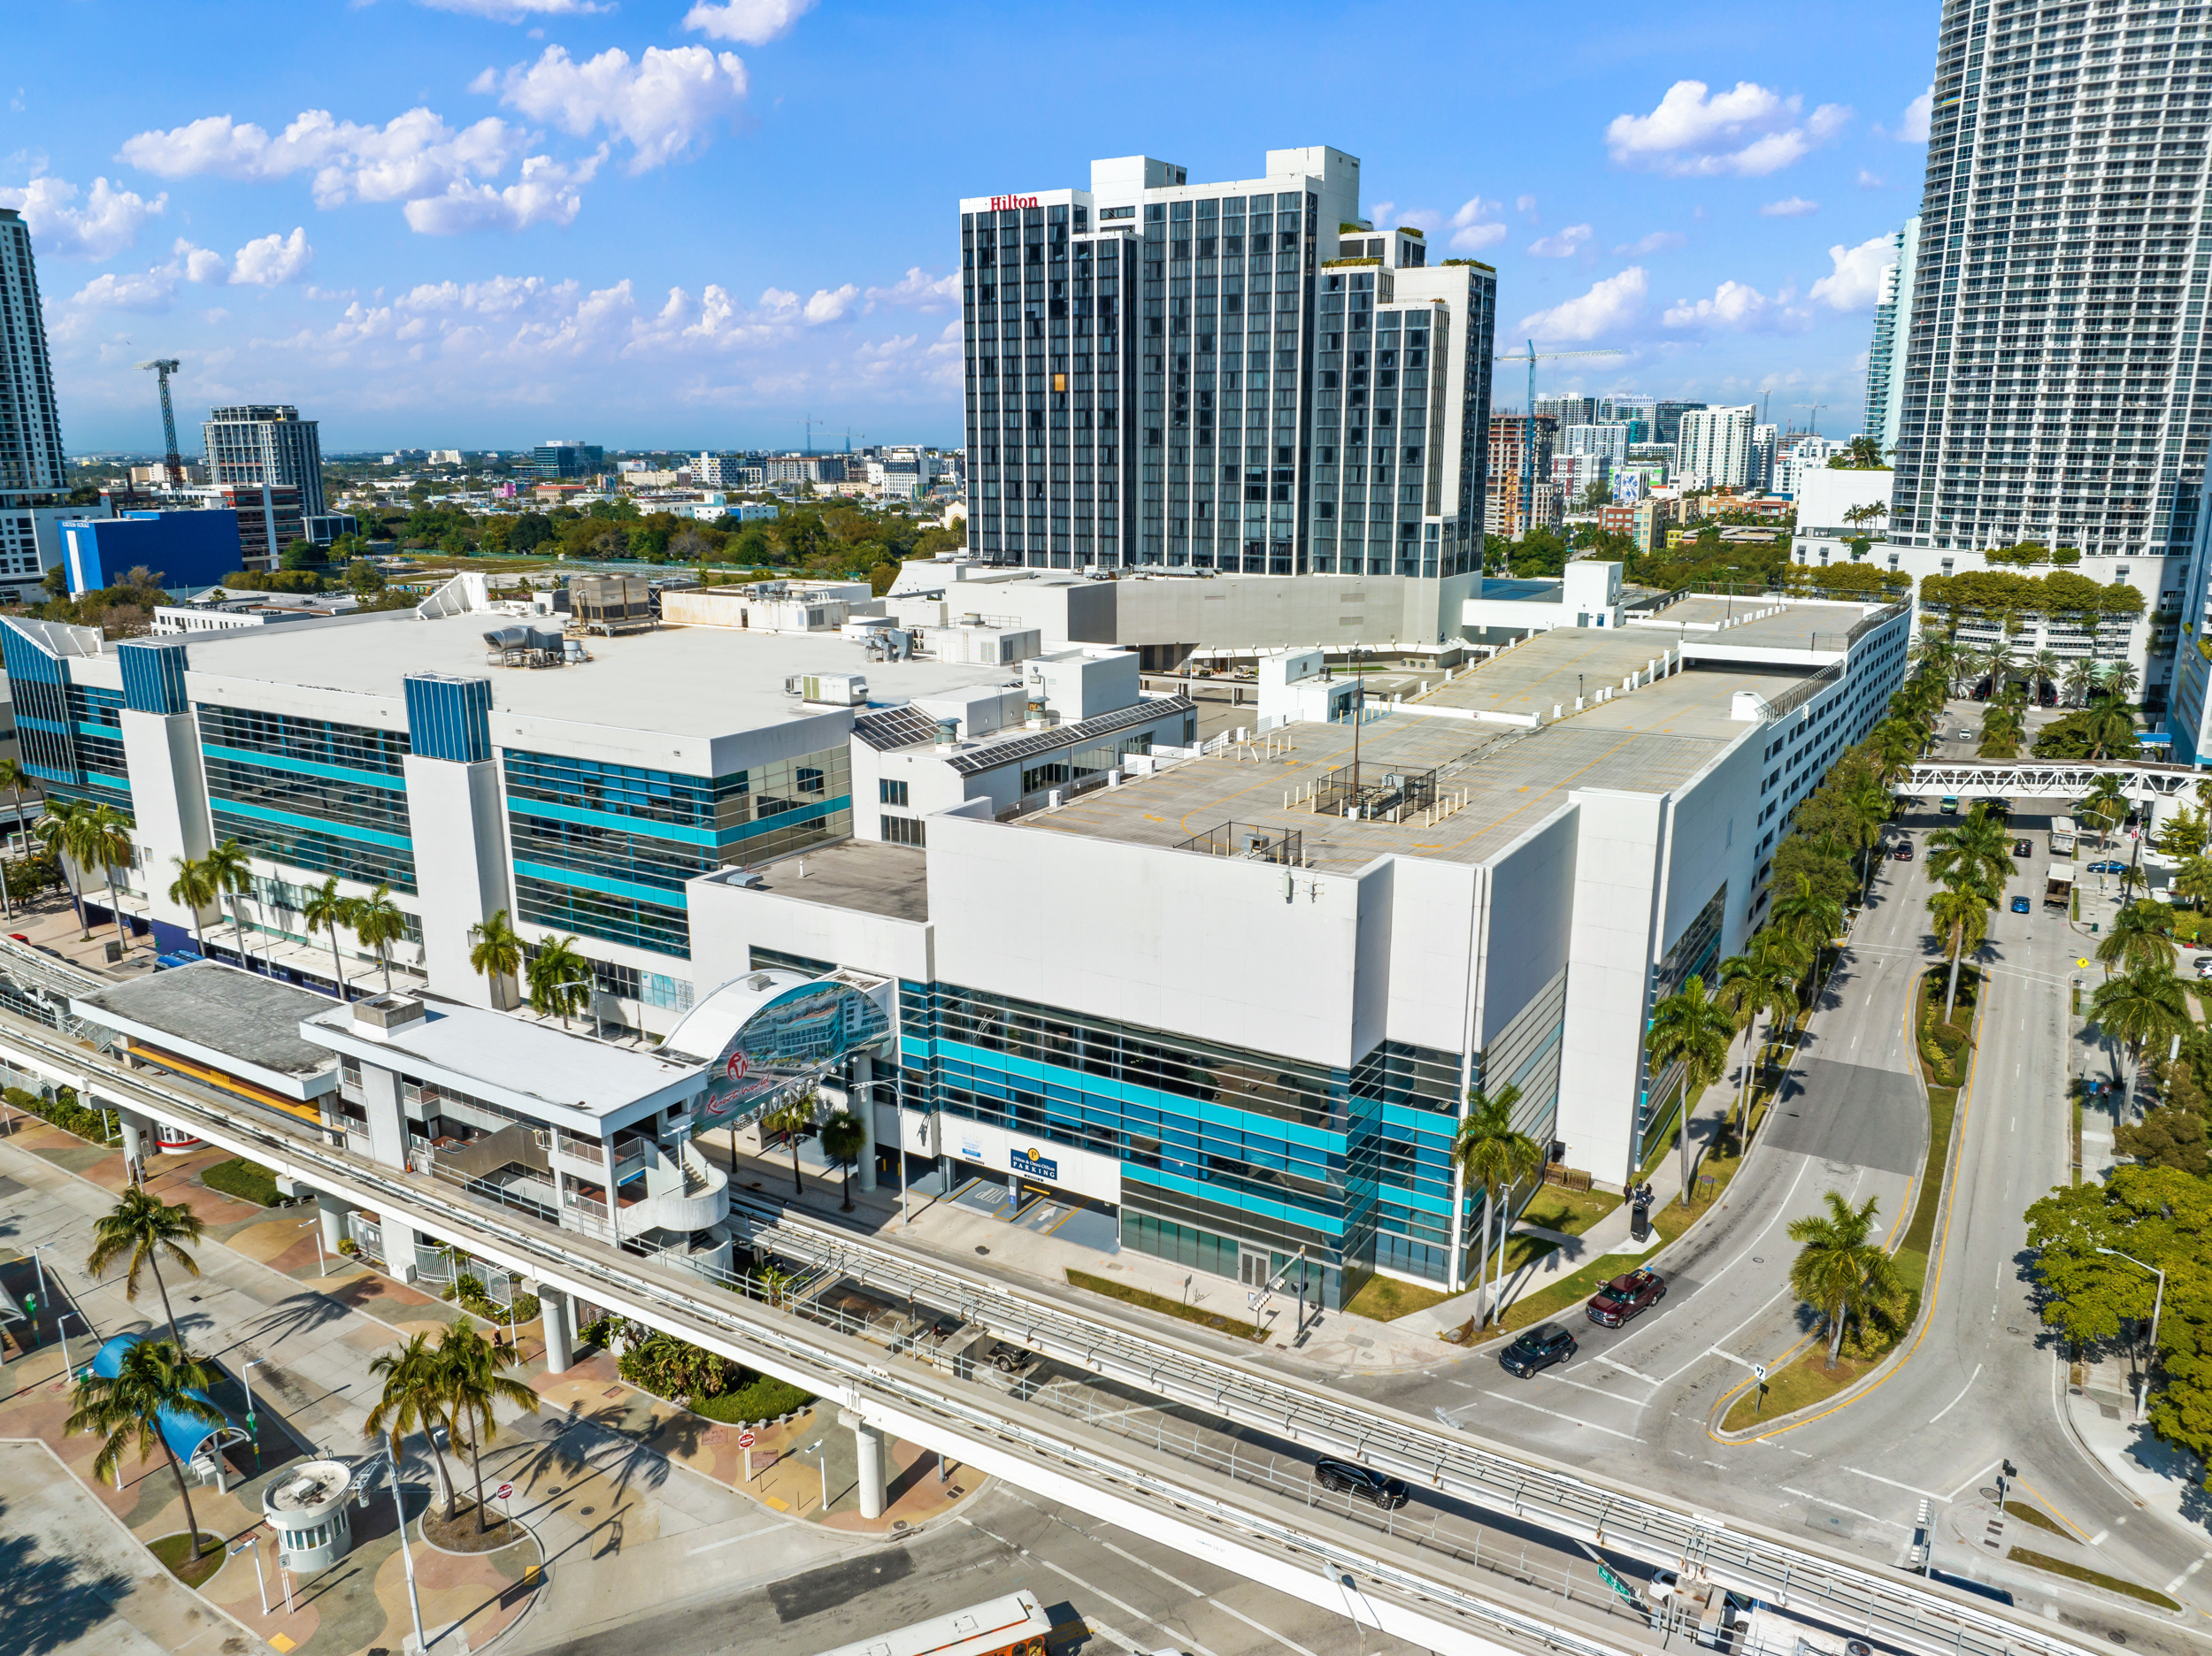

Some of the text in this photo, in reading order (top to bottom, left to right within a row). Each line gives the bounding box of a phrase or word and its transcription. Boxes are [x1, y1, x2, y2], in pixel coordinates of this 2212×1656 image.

[990, 194, 1038, 211] Hilton
[741, 1073, 771, 1095] World
[1013, 1161, 1055, 1177] PARKING
